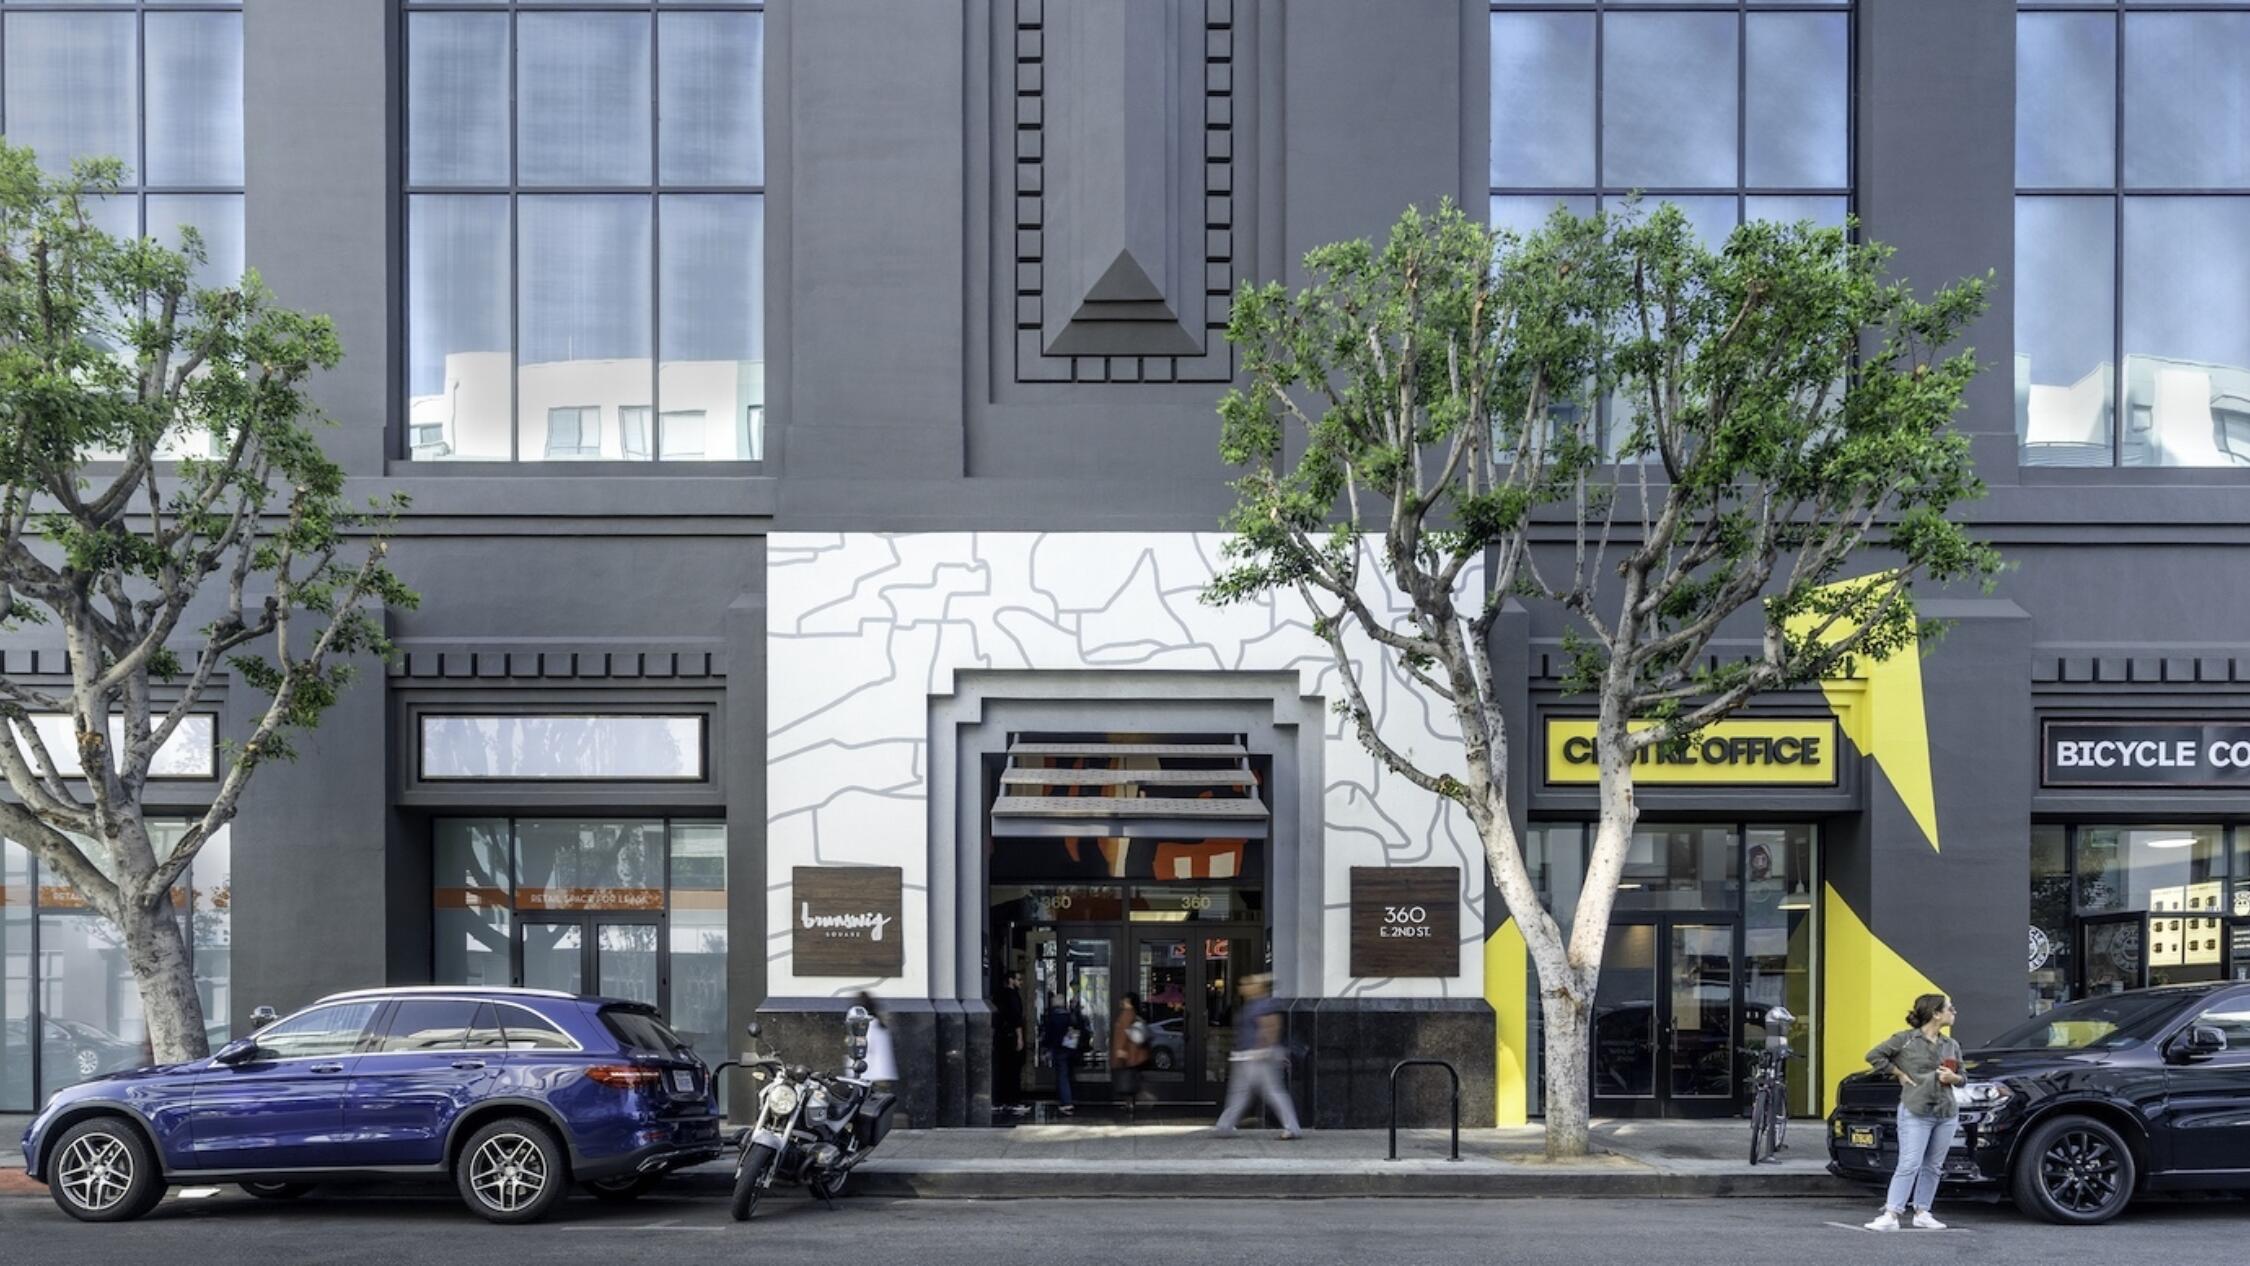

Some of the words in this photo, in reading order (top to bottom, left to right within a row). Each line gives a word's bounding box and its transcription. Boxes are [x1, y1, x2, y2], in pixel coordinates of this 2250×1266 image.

[1701, 736, 1820, 765] OFFICE
[2057, 741, 2196, 767] BICYCLE
[1182, 896, 1211, 909] 360
[1384, 906, 1426, 923] 360
[1391, 926, 1416, 937] 2ND
